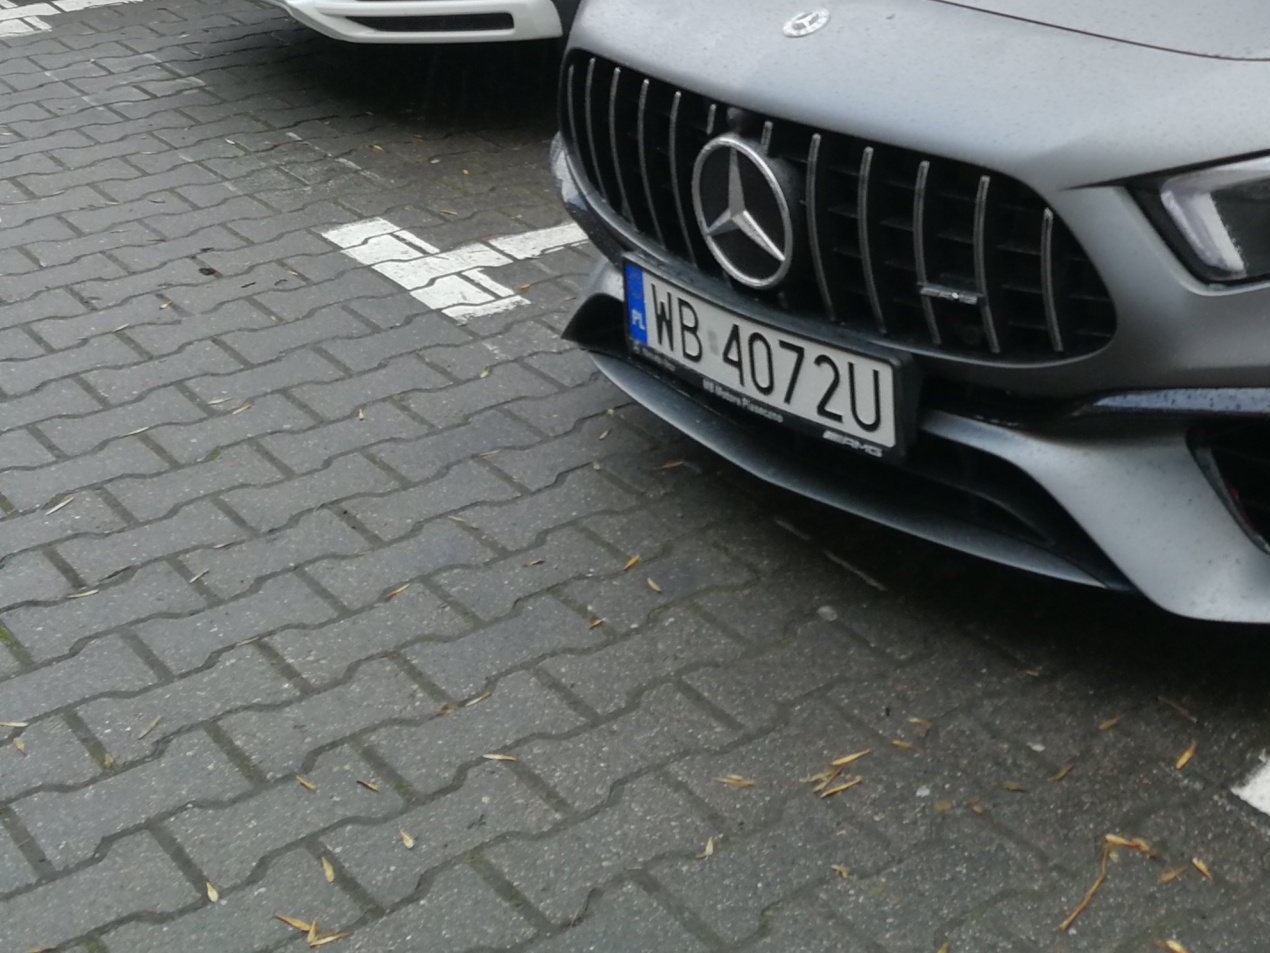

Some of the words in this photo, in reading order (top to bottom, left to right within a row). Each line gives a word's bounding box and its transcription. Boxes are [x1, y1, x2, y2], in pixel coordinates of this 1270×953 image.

[632, 309, 646, 330] PL
[651, 283, 702, 363] WB
[722, 324, 882, 433] 4072U
